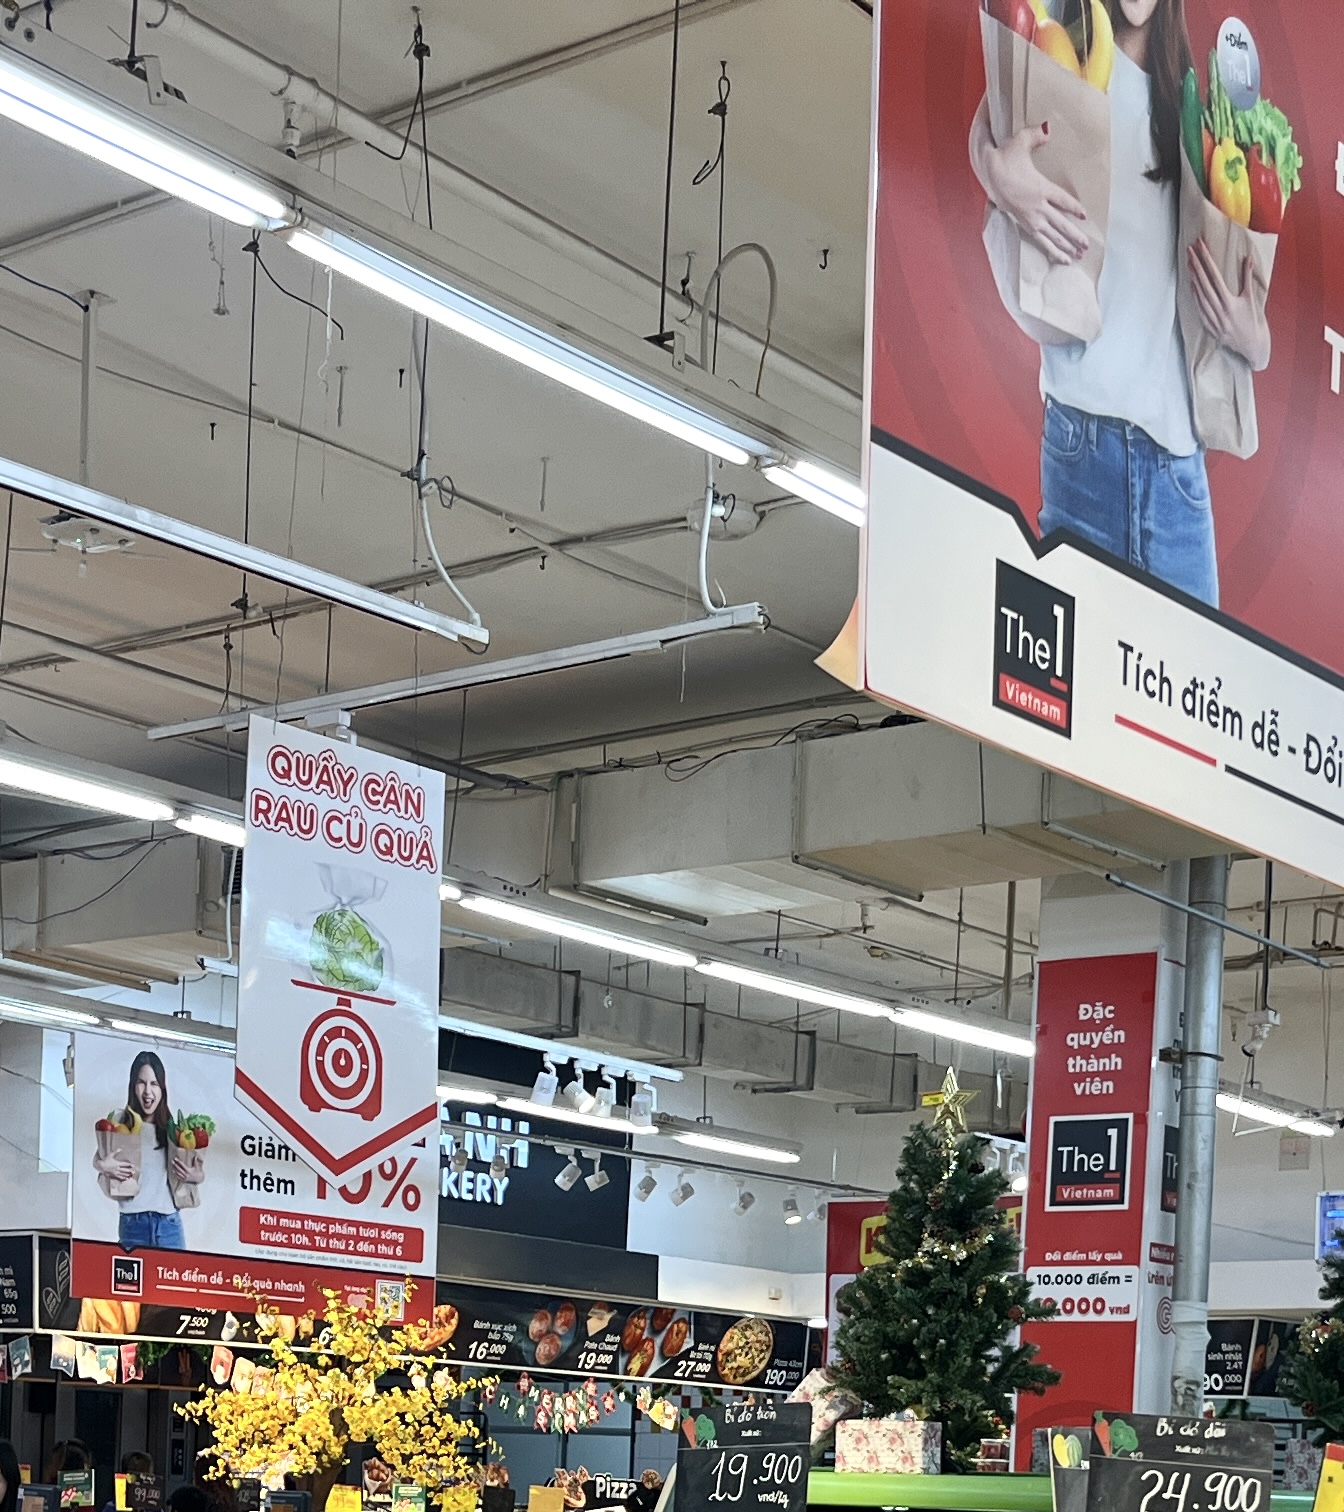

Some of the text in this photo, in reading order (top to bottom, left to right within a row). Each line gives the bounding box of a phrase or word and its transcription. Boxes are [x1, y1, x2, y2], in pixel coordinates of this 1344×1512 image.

[1005, 680, 1061, 722] Vietnam
[1118, 640, 1172, 707] Tích
[1181, 677, 1243, 740] điểm
[1251, 709, 1280, 757] dễ
[1304, 734, 1343, 787] Đổi
[267, 745, 424, 823] QUẦY CÂN
[251, 788, 438, 874] RAU CỦ QUẢ
[1078, 1002, 1115, 1024] Đặc
[1066, 1024, 1125, 1050] quyền
[1067, 1052, 1122, 1074] thành
[1073, 1078, 1114, 1095] viên
[240, 1134, 296, 1162] Giảm
[240, 1168, 295, 1196] thêm
[442, 1167, 509, 1205] KERY
[1062, 1185, 1114, 1199] Vietnam
[260, 1214, 404, 1243] Khi mua thực phẩm tươi sống
[260, 1229, 288, 1243] trước
[314, 1234, 327, 1248] Từ
[329, 1235, 345, 1250] thứ
[348, 1240, 355, 1251] 2
[356, 1239, 375, 1255] đến
[377, 1242, 394, 1257] thứ
[395, 1245, 402, 1257] 6
[156, 1265, 305, 1294] Tích điểm dễ quà nhanh
[1036, 1270, 1121, 1287] 10.000 điểm
[1109, 1302, 1130, 1316] vnd
[1208, 1351, 1223, 1362] sinh
[1221, 1341, 1242, 1351] Bánh
[595, 1472, 638, 1499] Pizza
[708, 1451, 802, 1501] 19.900
